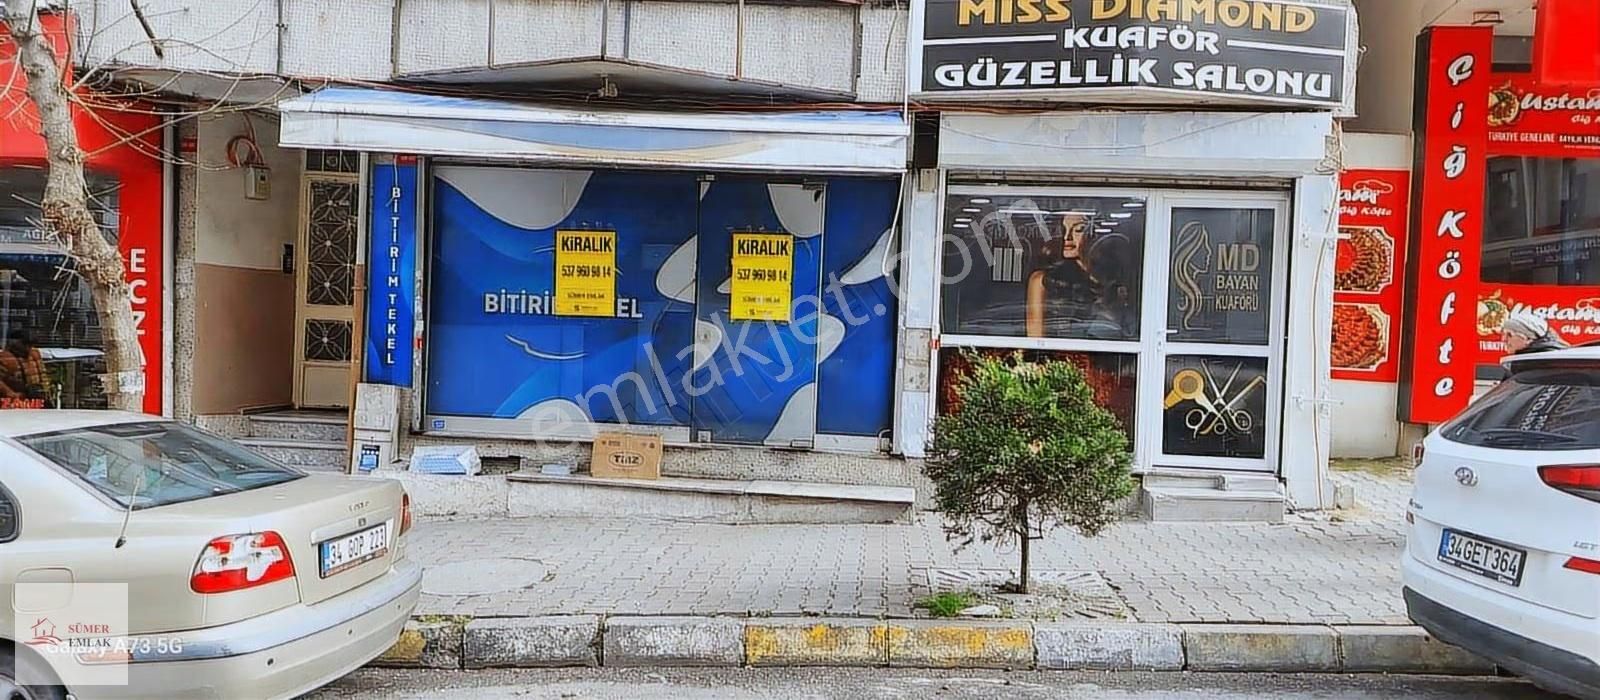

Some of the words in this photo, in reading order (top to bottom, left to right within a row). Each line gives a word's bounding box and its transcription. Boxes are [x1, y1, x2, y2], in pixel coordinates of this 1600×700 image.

[958, 0, 1071, 25] MISS
[1092, 0, 1316, 33] DIAMOND
[1064, 25, 1220, 55] KUAFÖR
[934, 54, 1158, 87] GÜZELLİK
[1173, 62, 1332, 98] SALONU
[1217, 243, 1259, 271] MD
[602, 266, 612, 278] 14
[779, 269, 788, 282] 14
[1216, 275, 1259, 290] BAYAN
[485, 289, 557, 315] BİTİRİ
[1435, 211, 1466, 396] Köfte
[387, 294, 398, 364] TEKEL
